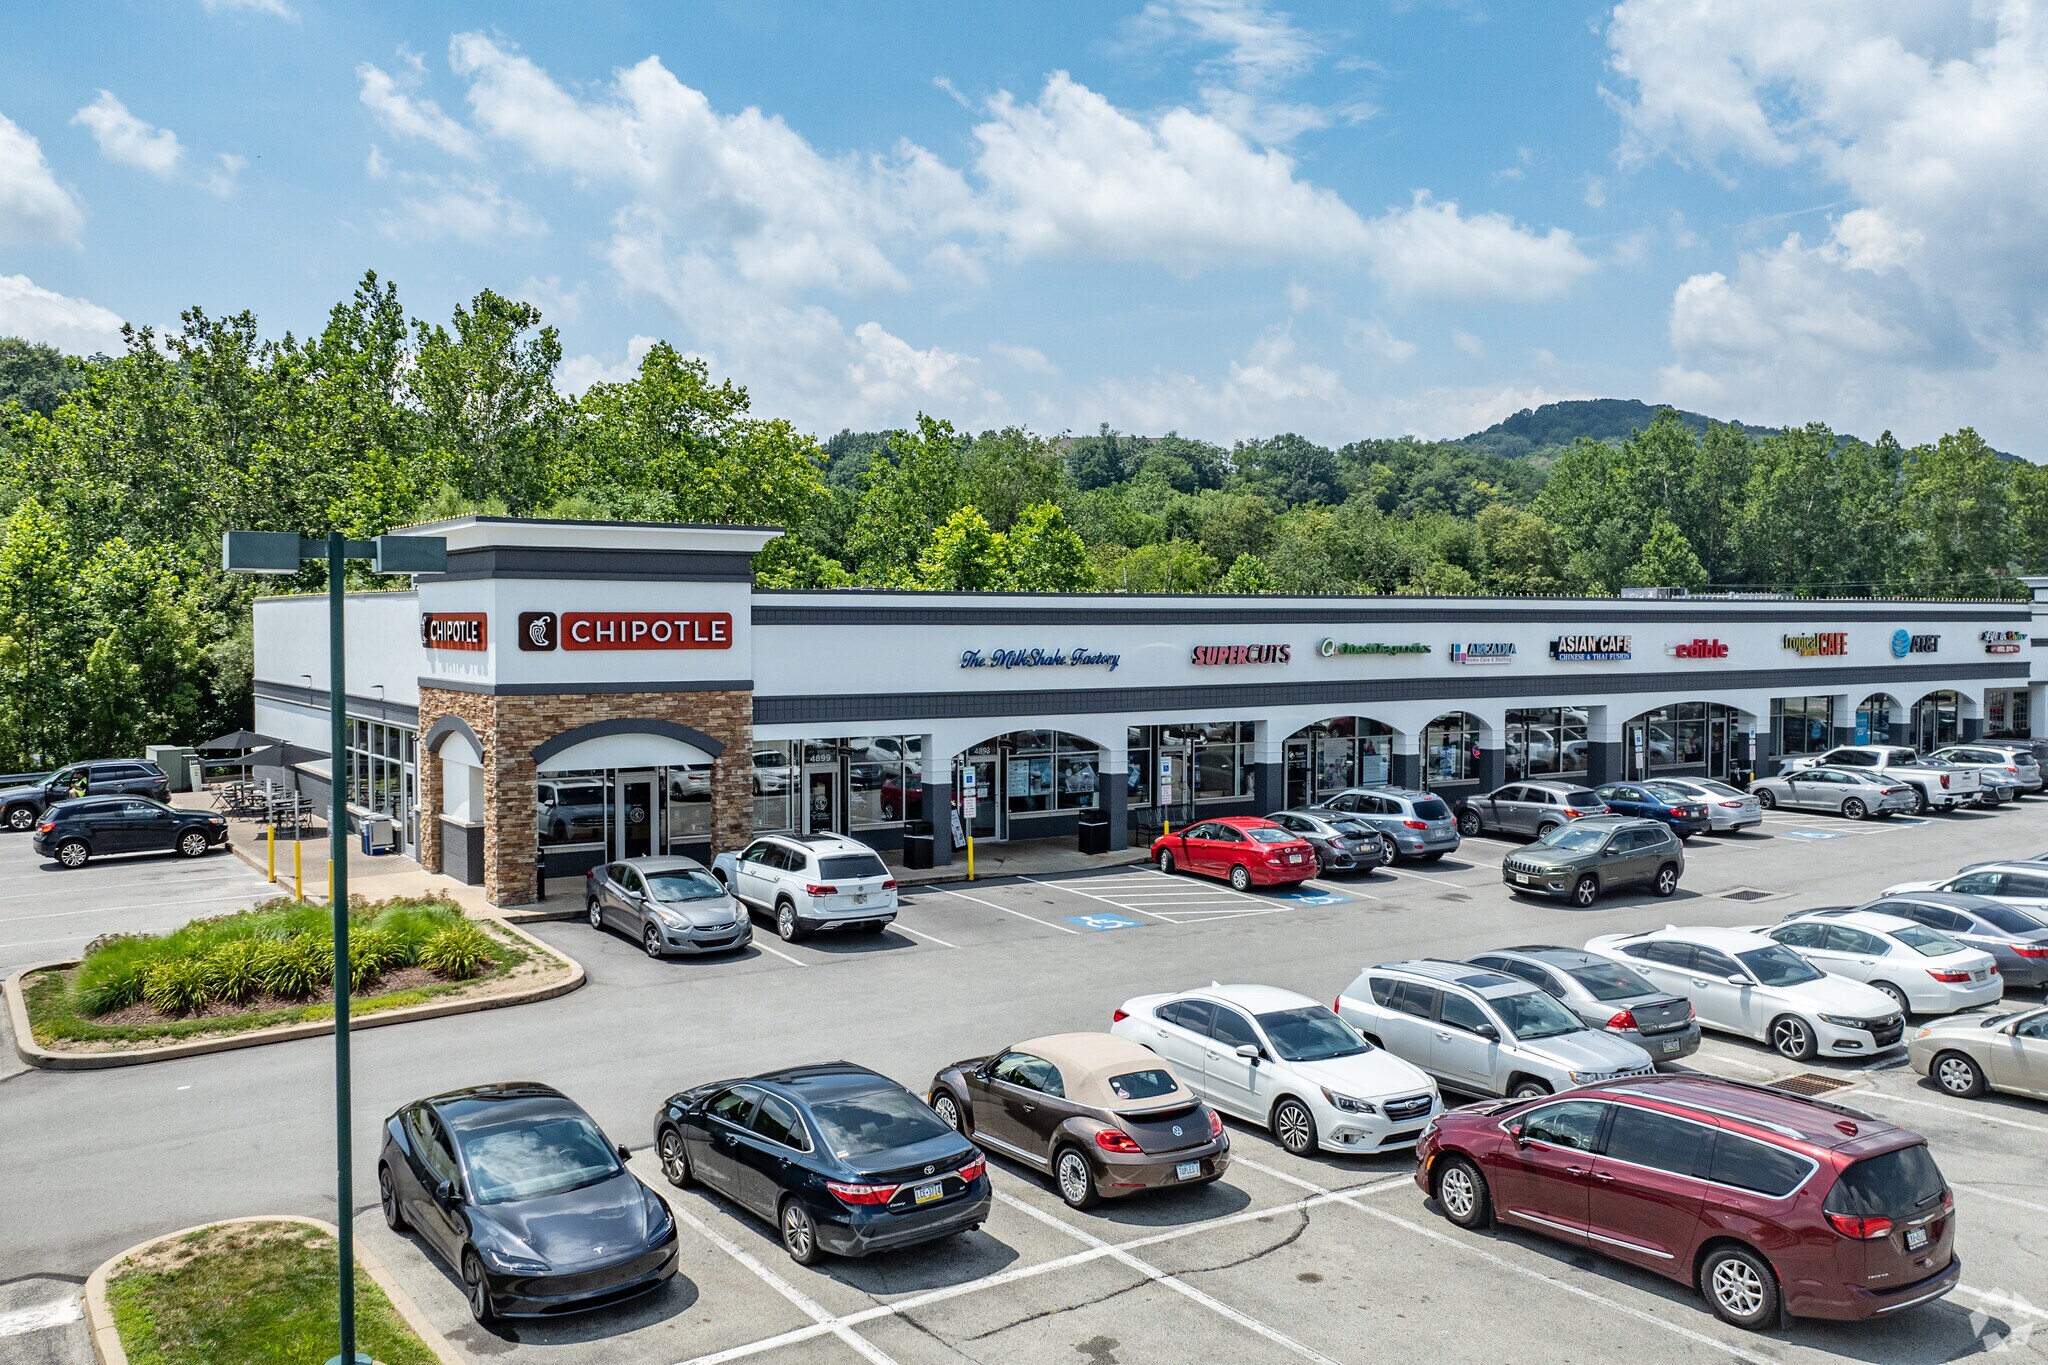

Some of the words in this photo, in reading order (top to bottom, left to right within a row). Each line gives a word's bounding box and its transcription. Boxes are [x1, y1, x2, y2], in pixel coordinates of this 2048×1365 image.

[430, 620, 479, 642] CHIPOTLE
[571, 620, 728, 642] CHIPOTLE
[1339, 642, 1374, 655] Quest
[1374, 642, 1432, 656] Diagnostics
[1467, 643, 1517, 655] ARCADIA
[1558, 635, 1597, 653] ASIAN
[1600, 635, 1632, 652] CAFE
[1676, 639, 1729, 658] edible
[1783, 632, 1818, 652] tropical
[1819, 632, 1849, 656] CAFE
[1909, 635, 1941, 653] AT&T
[959, 649, 986, 669] The
[989, 648, 1067, 670] MilkShake
[1069, 647, 1121, 672] Factory
[1192, 644, 1292, 666] SUPERCUTS
[1559, 653, 1585, 661] CHINESE
[1609, 652, 1630, 660] FUSION
[810, 754, 832, 763] 4899
[973, 746, 991, 755] 4893
